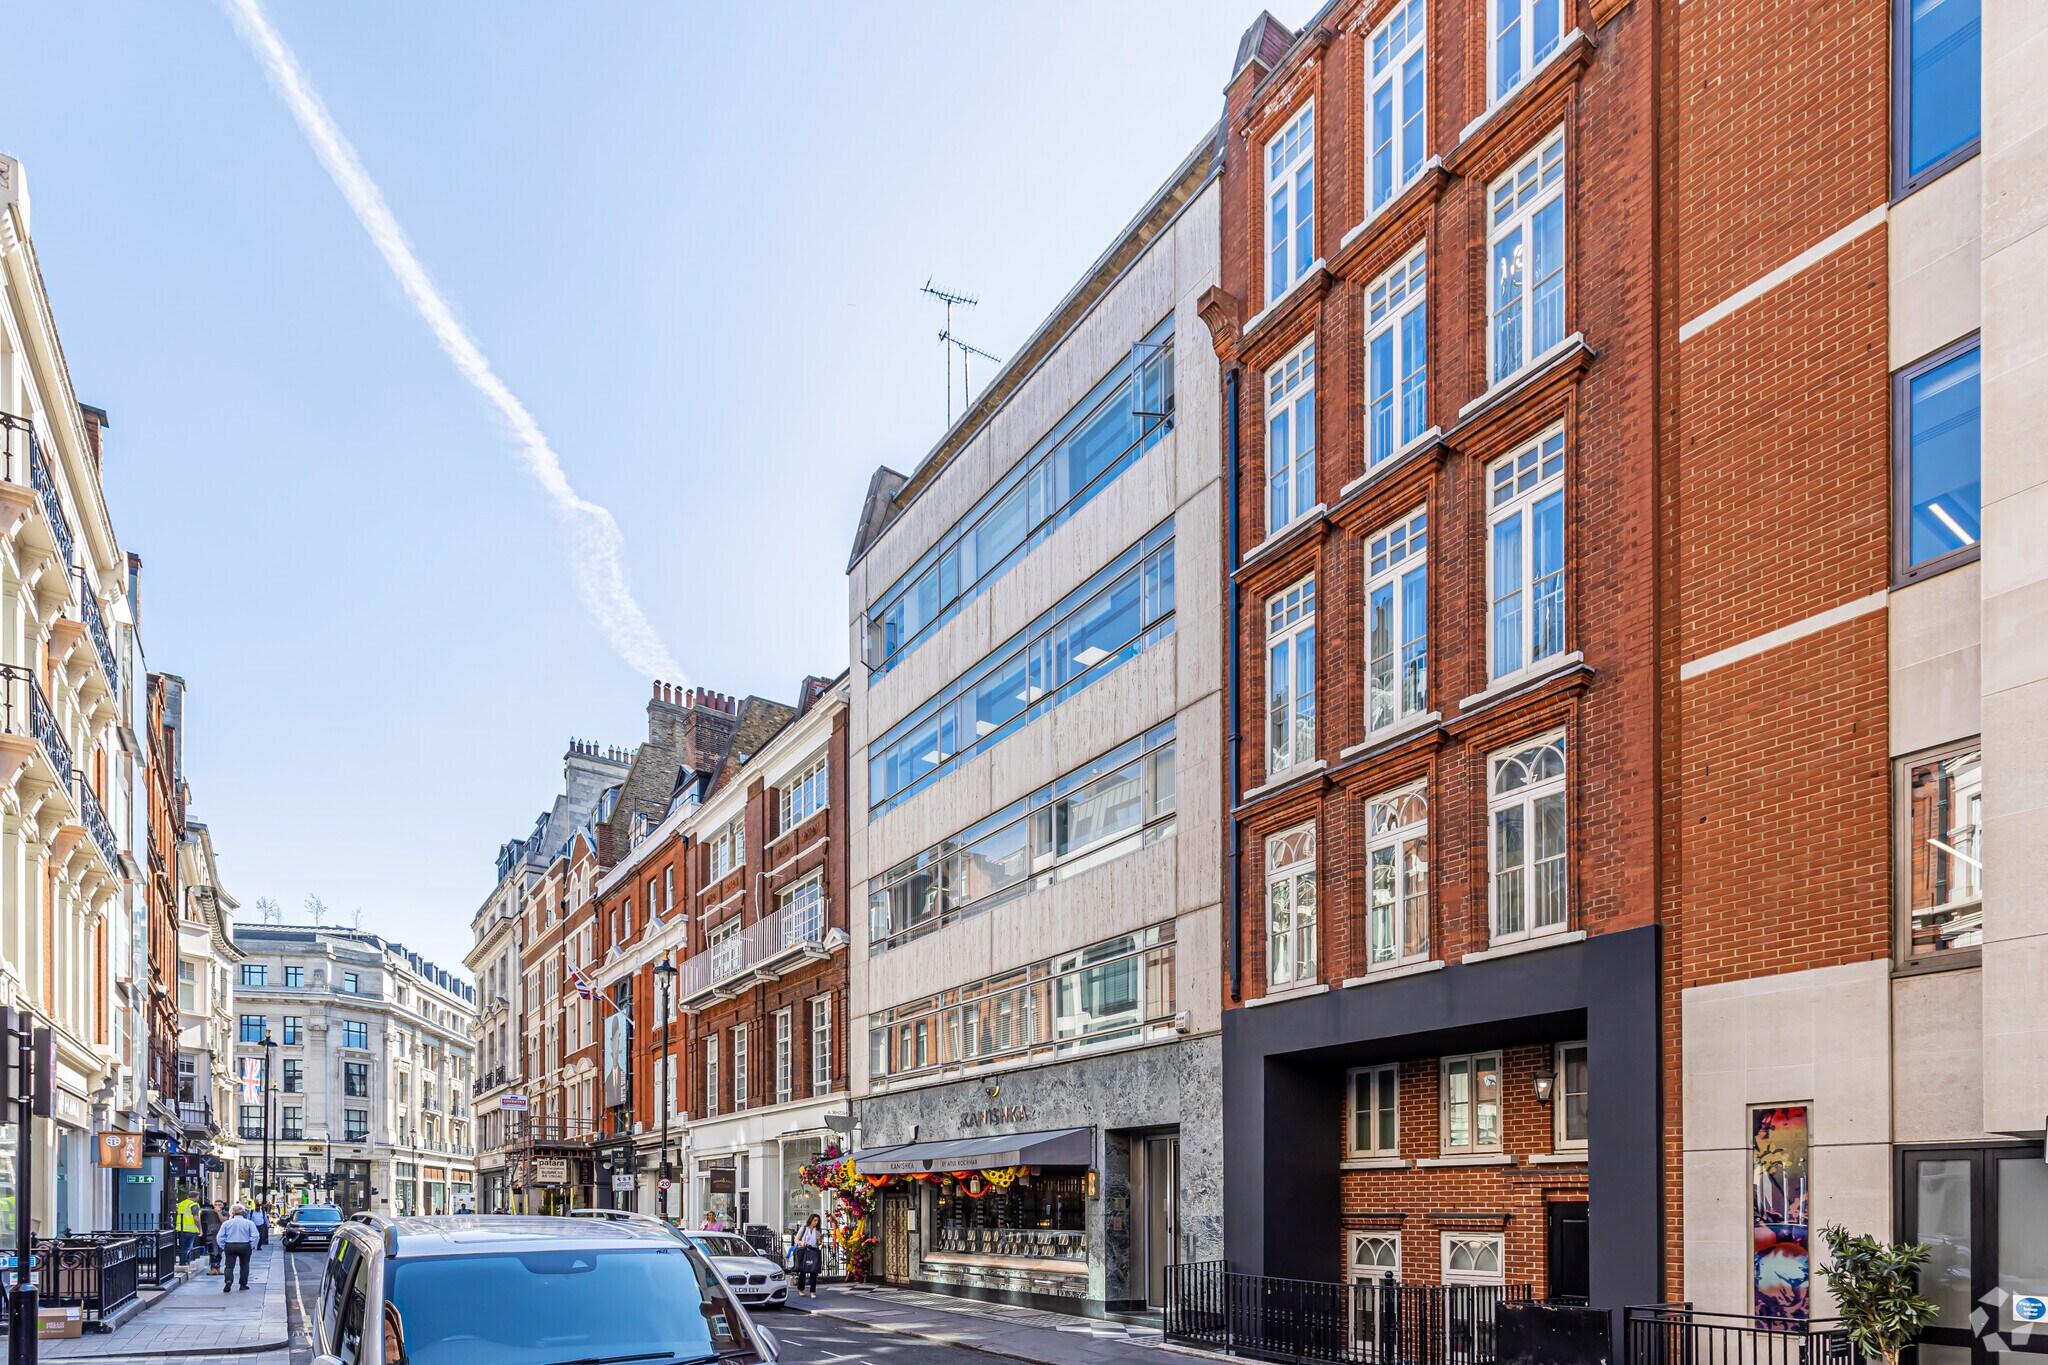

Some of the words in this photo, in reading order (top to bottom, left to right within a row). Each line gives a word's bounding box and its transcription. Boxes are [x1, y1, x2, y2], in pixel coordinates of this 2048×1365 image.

[65, 1097, 79, 1119] HANA
[960, 1104, 1028, 1128] KANISHKA
[126, 1137, 135, 1164] HANA
